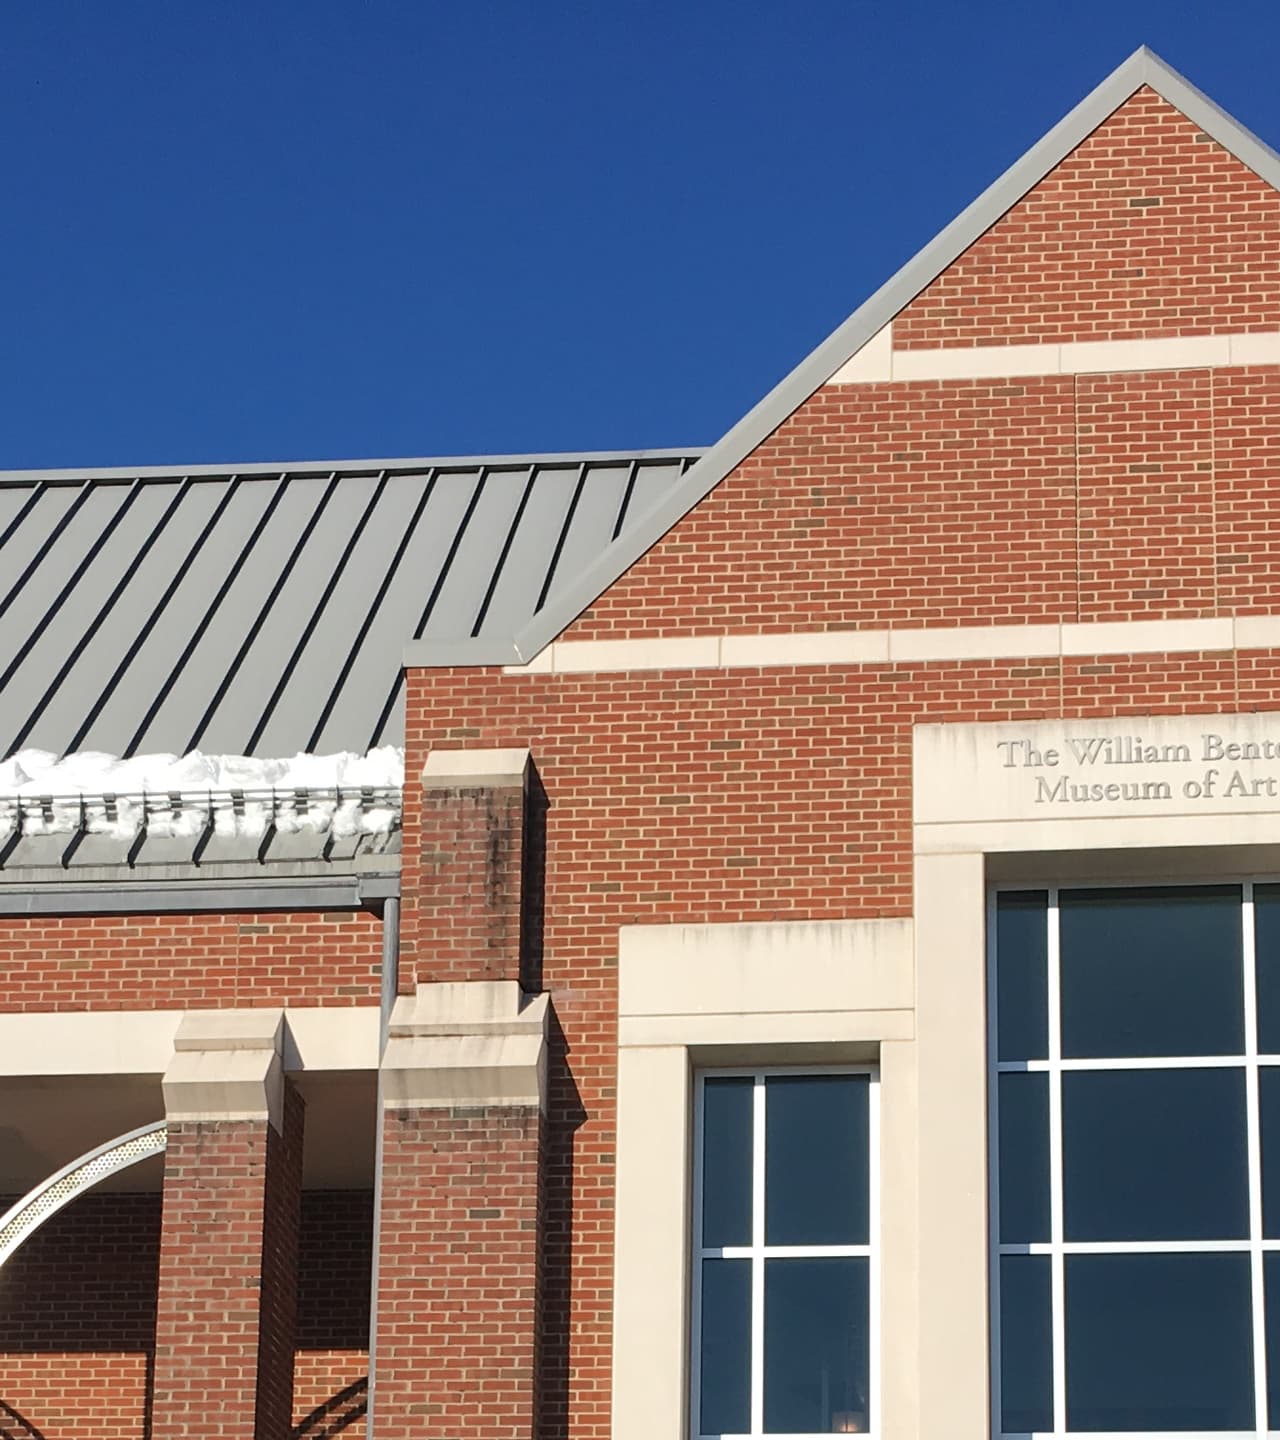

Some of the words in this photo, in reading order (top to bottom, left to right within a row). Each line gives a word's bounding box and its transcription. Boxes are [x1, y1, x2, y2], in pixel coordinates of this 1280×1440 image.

[996, 738, 1059, 768] The
[1065, 735, 1192, 765] William
[1034, 774, 1172, 803] Museum
[1183, 769, 1217, 799] of
[1223, 771, 1278, 798] Art
